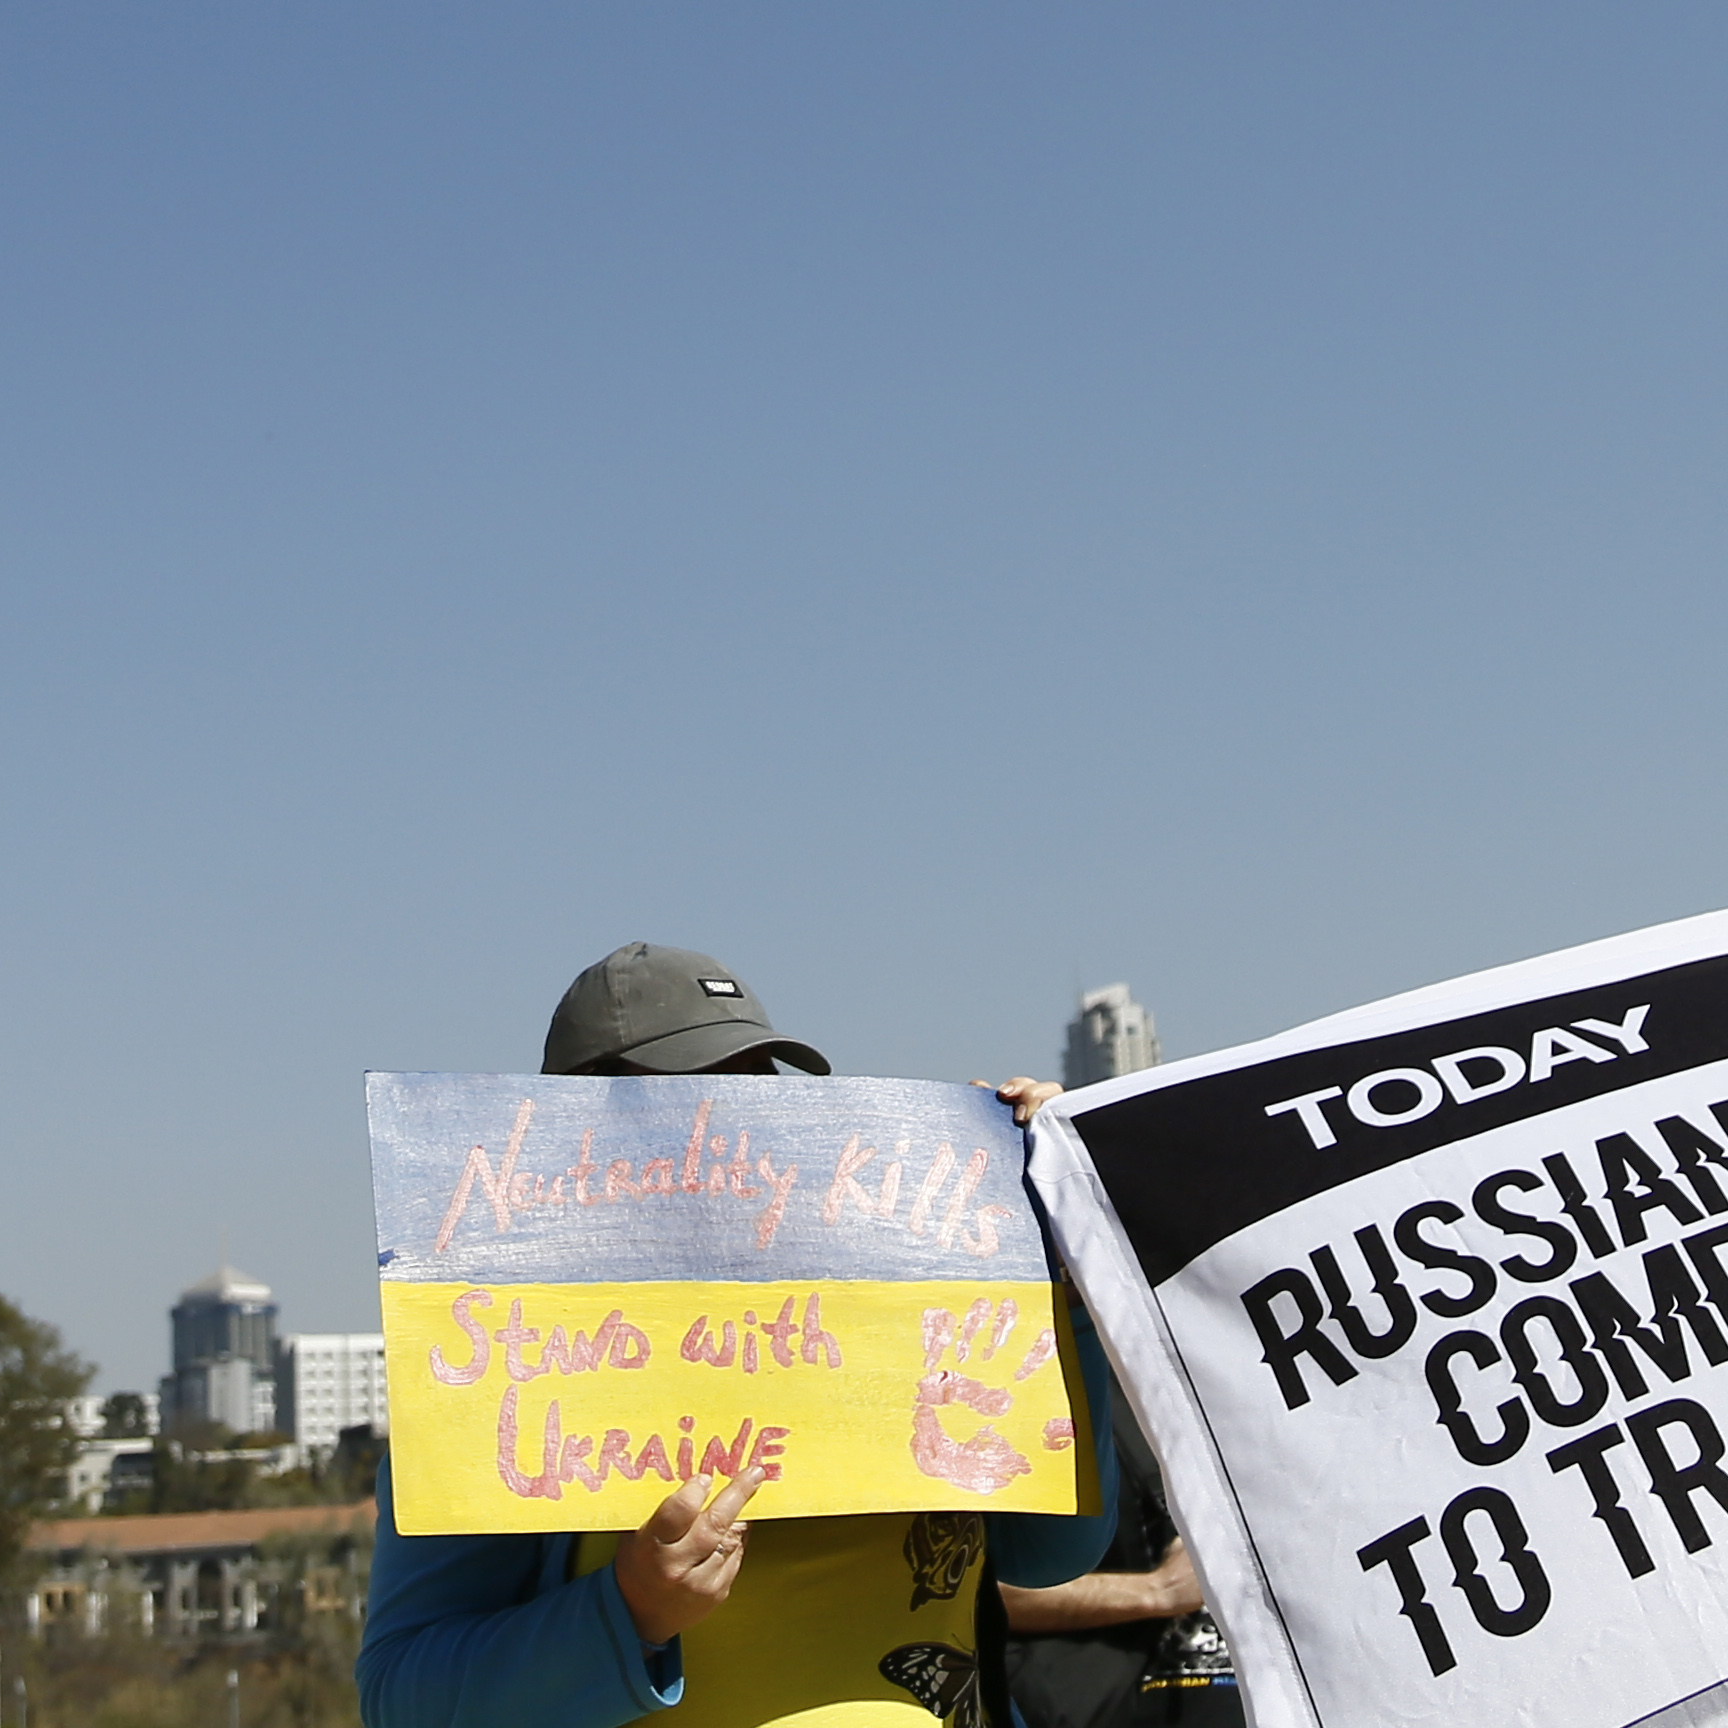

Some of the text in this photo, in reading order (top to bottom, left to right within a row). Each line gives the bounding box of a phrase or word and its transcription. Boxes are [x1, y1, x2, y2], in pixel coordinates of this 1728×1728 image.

[1264, 1003, 1652, 1150] TODAY
[432, 1098, 799, 1253] Neutrality
[680, 1292, 843, 1373] with
[1355, 1485, 1553, 1677] TO
